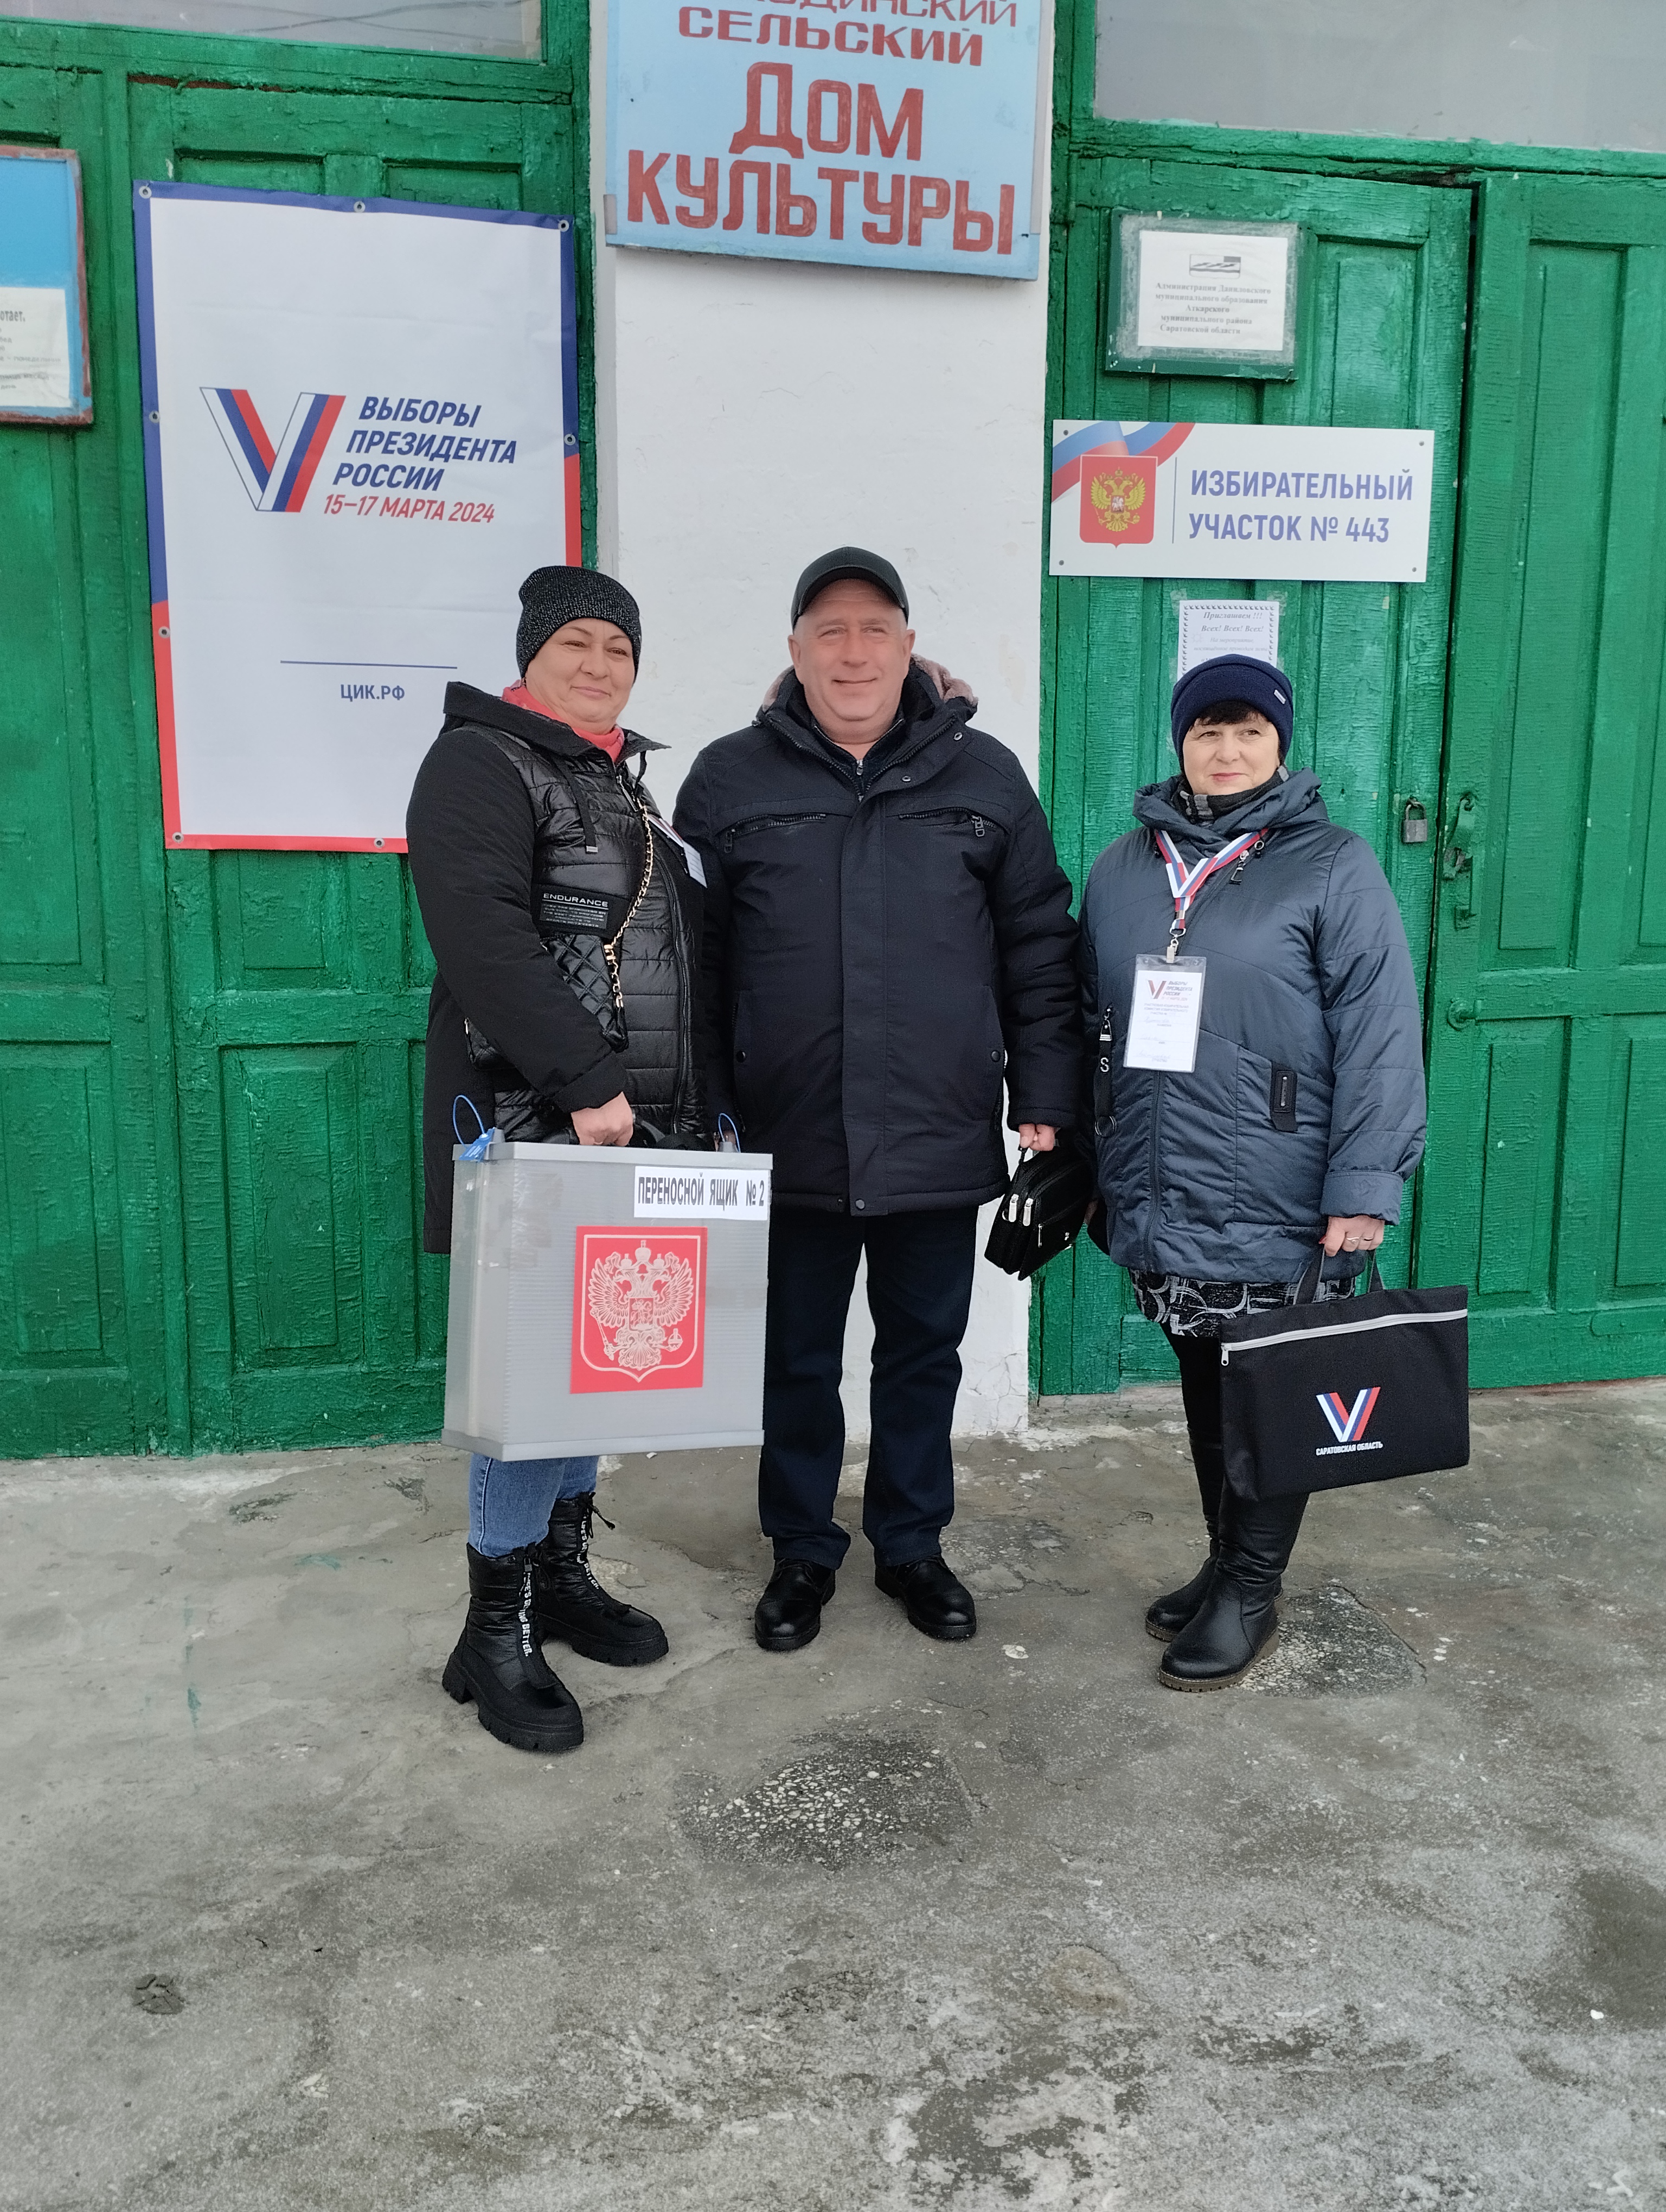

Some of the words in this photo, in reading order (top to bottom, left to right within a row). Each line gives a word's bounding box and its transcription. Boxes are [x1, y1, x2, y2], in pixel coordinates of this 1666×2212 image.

[679, 7, 983, 66] СЕЛЬСКИЙ
[729, 61, 924, 161] ДОМ
[627, 150, 1015, 255] КУЛЬТУРЫ
[1156, 282, 1216, 292] Администрация
[1218, 285, 1271, 294] Даниловского
[1156, 293, 1219, 302] муниципального
[1221, 295, 1268, 304] образования
[1161, 315, 1224, 324] муниципального
[1186, 305, 1230, 313] Аткарского
[1160, 324, 1209, 333] Саратовской
[358, 396, 482, 427] ВЫБОРЫ
[346, 430, 517, 464] ПРЕЗИДЕНТА
[332, 462, 445, 491] РОССИИ
[1191, 468, 1413, 500] ИЗБИРАТЕЛЬНЫЙ
[379, 496, 445, 520] МАРТА
[447, 501, 495, 523] 2024
[1189, 513, 1302, 541] УЧАСТОК
[1310, 516, 1338, 541] №
[1345, 517, 1389, 543] 443
[1203, 612, 1251, 620] Приглашаем
[341, 684, 405, 702] ЦИК.РФ
[543, 893, 608, 908] ENDURANCE
[638, 1172, 704, 1206] ПЕРЕНОСНОЙ
[709, 1179, 738, 1212] ЯЩИК
[1316, 1444, 1356, 1456] САРАТОВСКАЯ
[1357, 1441, 1383, 1451] ОБЛАСТЬ
[522, 1623, 533, 1657] BETTER.
